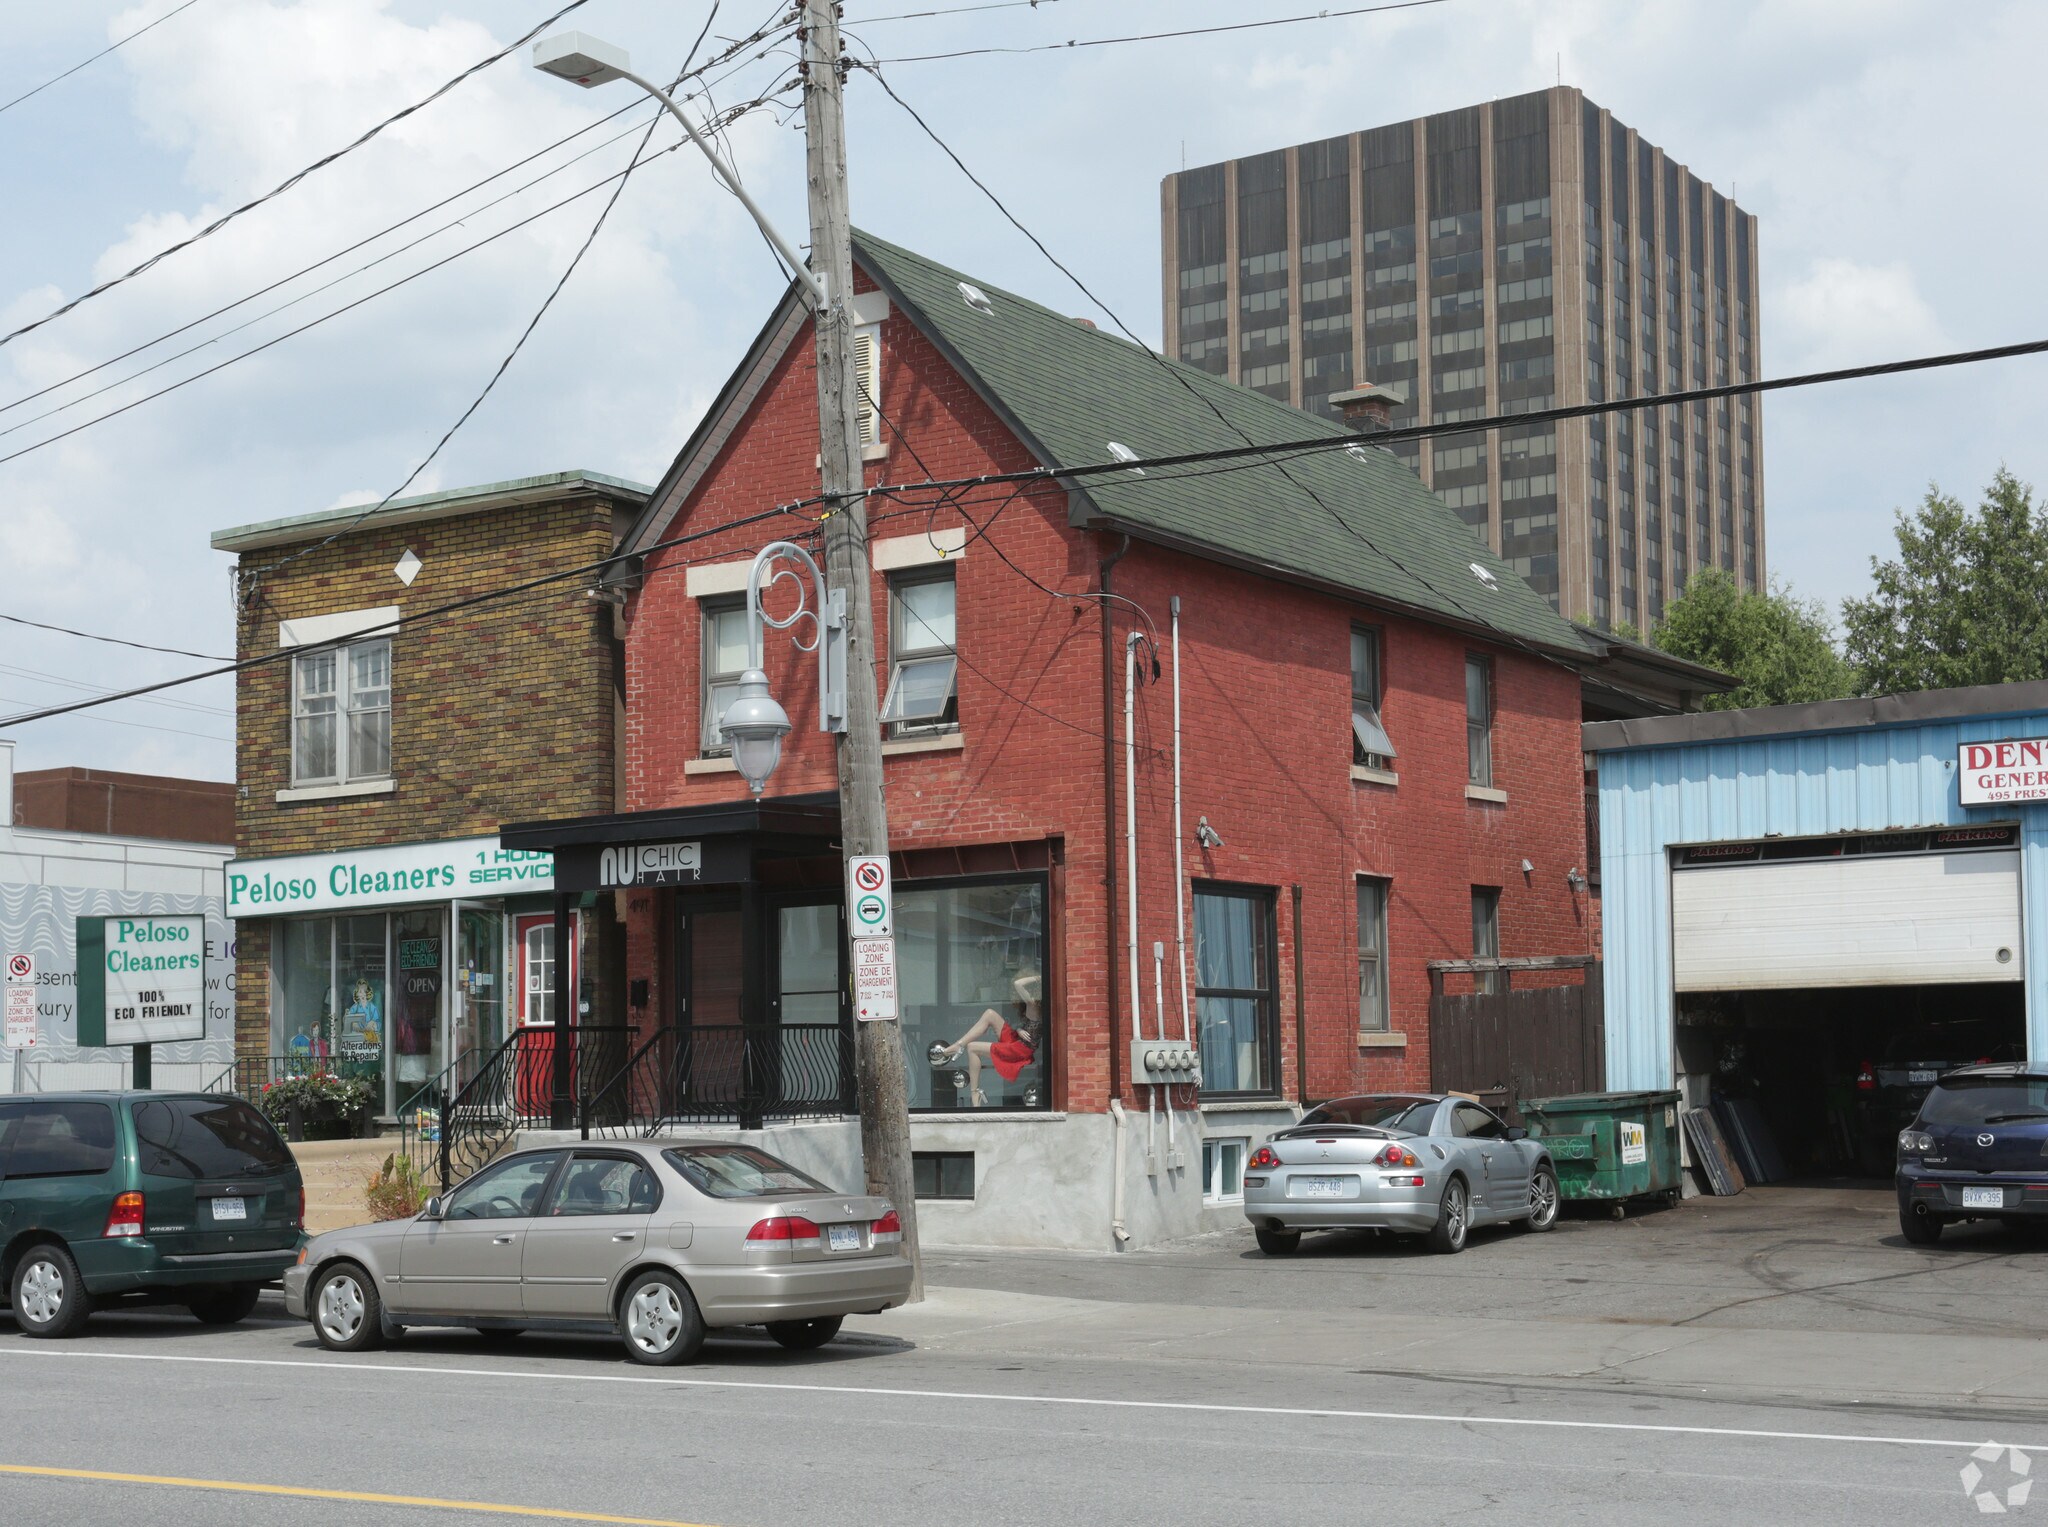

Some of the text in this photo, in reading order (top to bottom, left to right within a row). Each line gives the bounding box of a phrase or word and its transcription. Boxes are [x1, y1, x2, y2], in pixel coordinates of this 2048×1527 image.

[1967, 741, 2048, 770] DEN
[1988, 789, 2048, 800] 495 PRES
[1938, 829, 2009, 842] PARKING
[476, 851, 486, 865] 1
[642, 845, 693, 868] CHIC
[469, 863, 555, 884] SERVIC
[636, 868, 701, 884] HAIR
[229, 864, 456, 905] Peloso Cleaners
[117, 920, 190, 943] Peloso
[410, 940, 428, 954] CLEAN
[858, 943, 889, 953] LOADING
[106, 949, 200, 973] Cleaners
[865, 953, 884, 963] ZONE
[859, 966, 891, 976] ZONE DE
[407, 977, 436, 993] OPEN
[858, 977, 892, 987] CHARGEMENT
[13, 997, 29, 1005] ZONE
[138, 990, 165, 1003] 100%
[26, 1007, 34, 1015] DE
[114, 1003, 192, 1020] ECO FRIENDLY
[208, 1000, 230, 1019] for
[341, 1040, 382, 1052] Alterations
[350, 1050, 379, 1062] Repairs
[1622, 1130, 1643, 1147] WM
